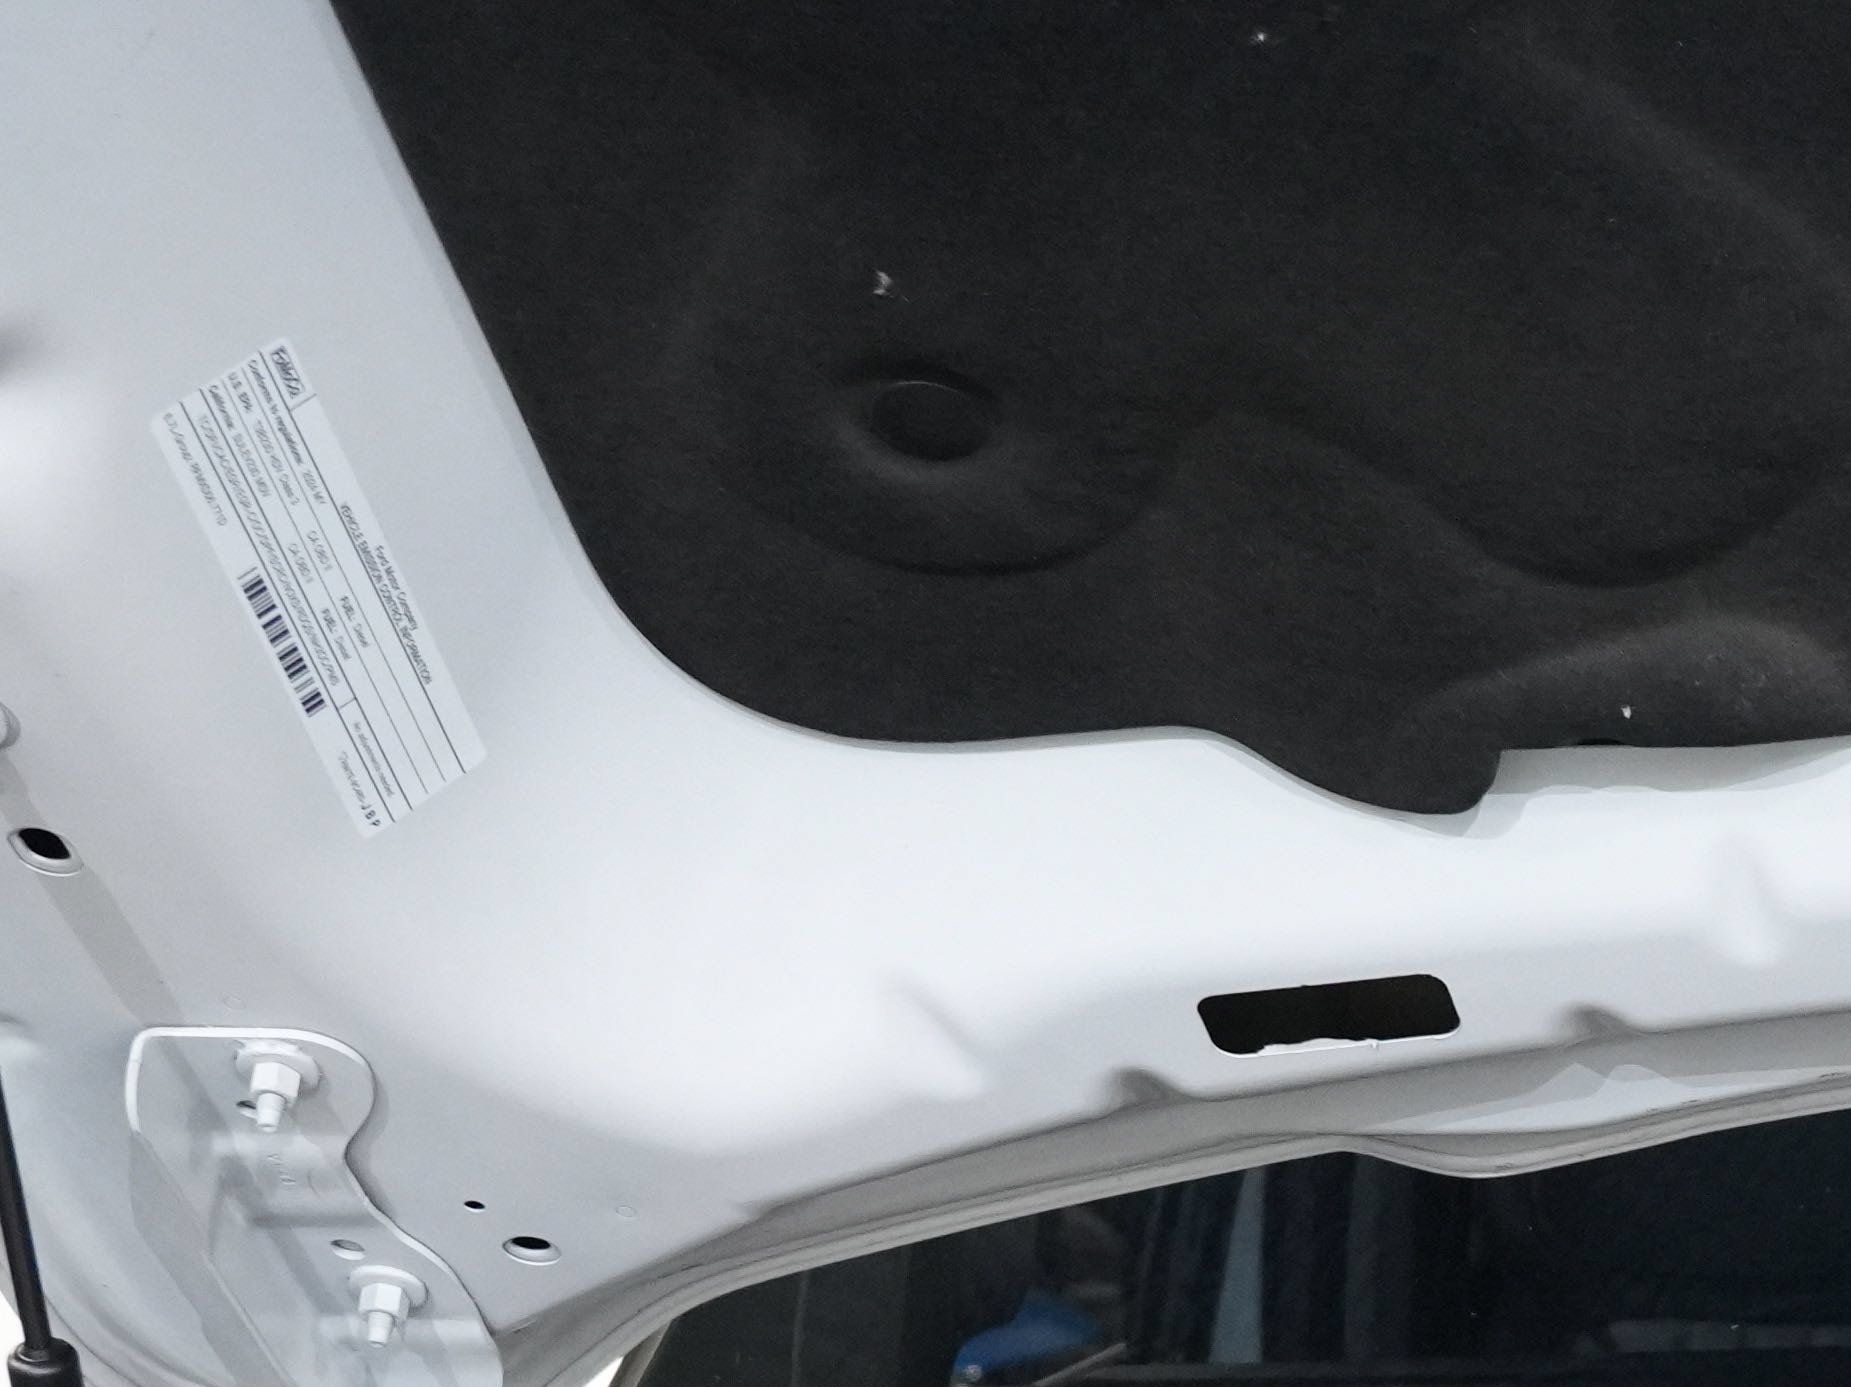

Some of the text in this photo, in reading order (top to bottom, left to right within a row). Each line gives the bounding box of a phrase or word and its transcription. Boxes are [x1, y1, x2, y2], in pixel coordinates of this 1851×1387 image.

[357, 539, 384, 584] EMISSION
[378, 582, 404, 625] CONTROL
[398, 624, 433, 685] INFORMATION
